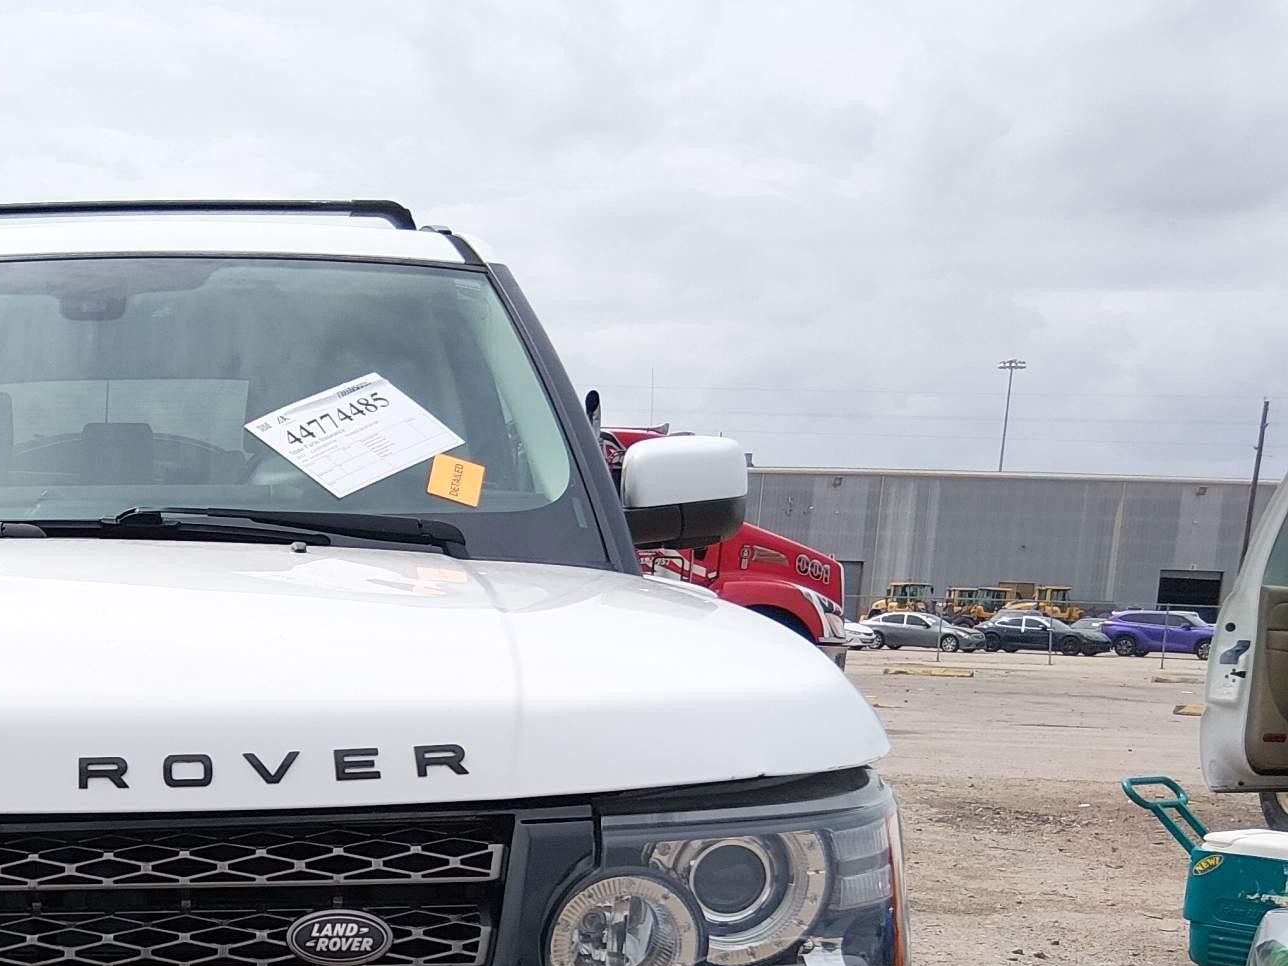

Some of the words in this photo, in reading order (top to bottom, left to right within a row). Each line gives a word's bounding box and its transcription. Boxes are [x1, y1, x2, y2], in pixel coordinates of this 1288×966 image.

[286, 392, 390, 445] 44774485
[449, 463, 464, 497] DETAILED
[795, 554, 831, 585] 001
[77, 743, 470, 790] ROVER
[311, 923, 358, 937] LAND
[316, 937, 373, 951] ROVER
